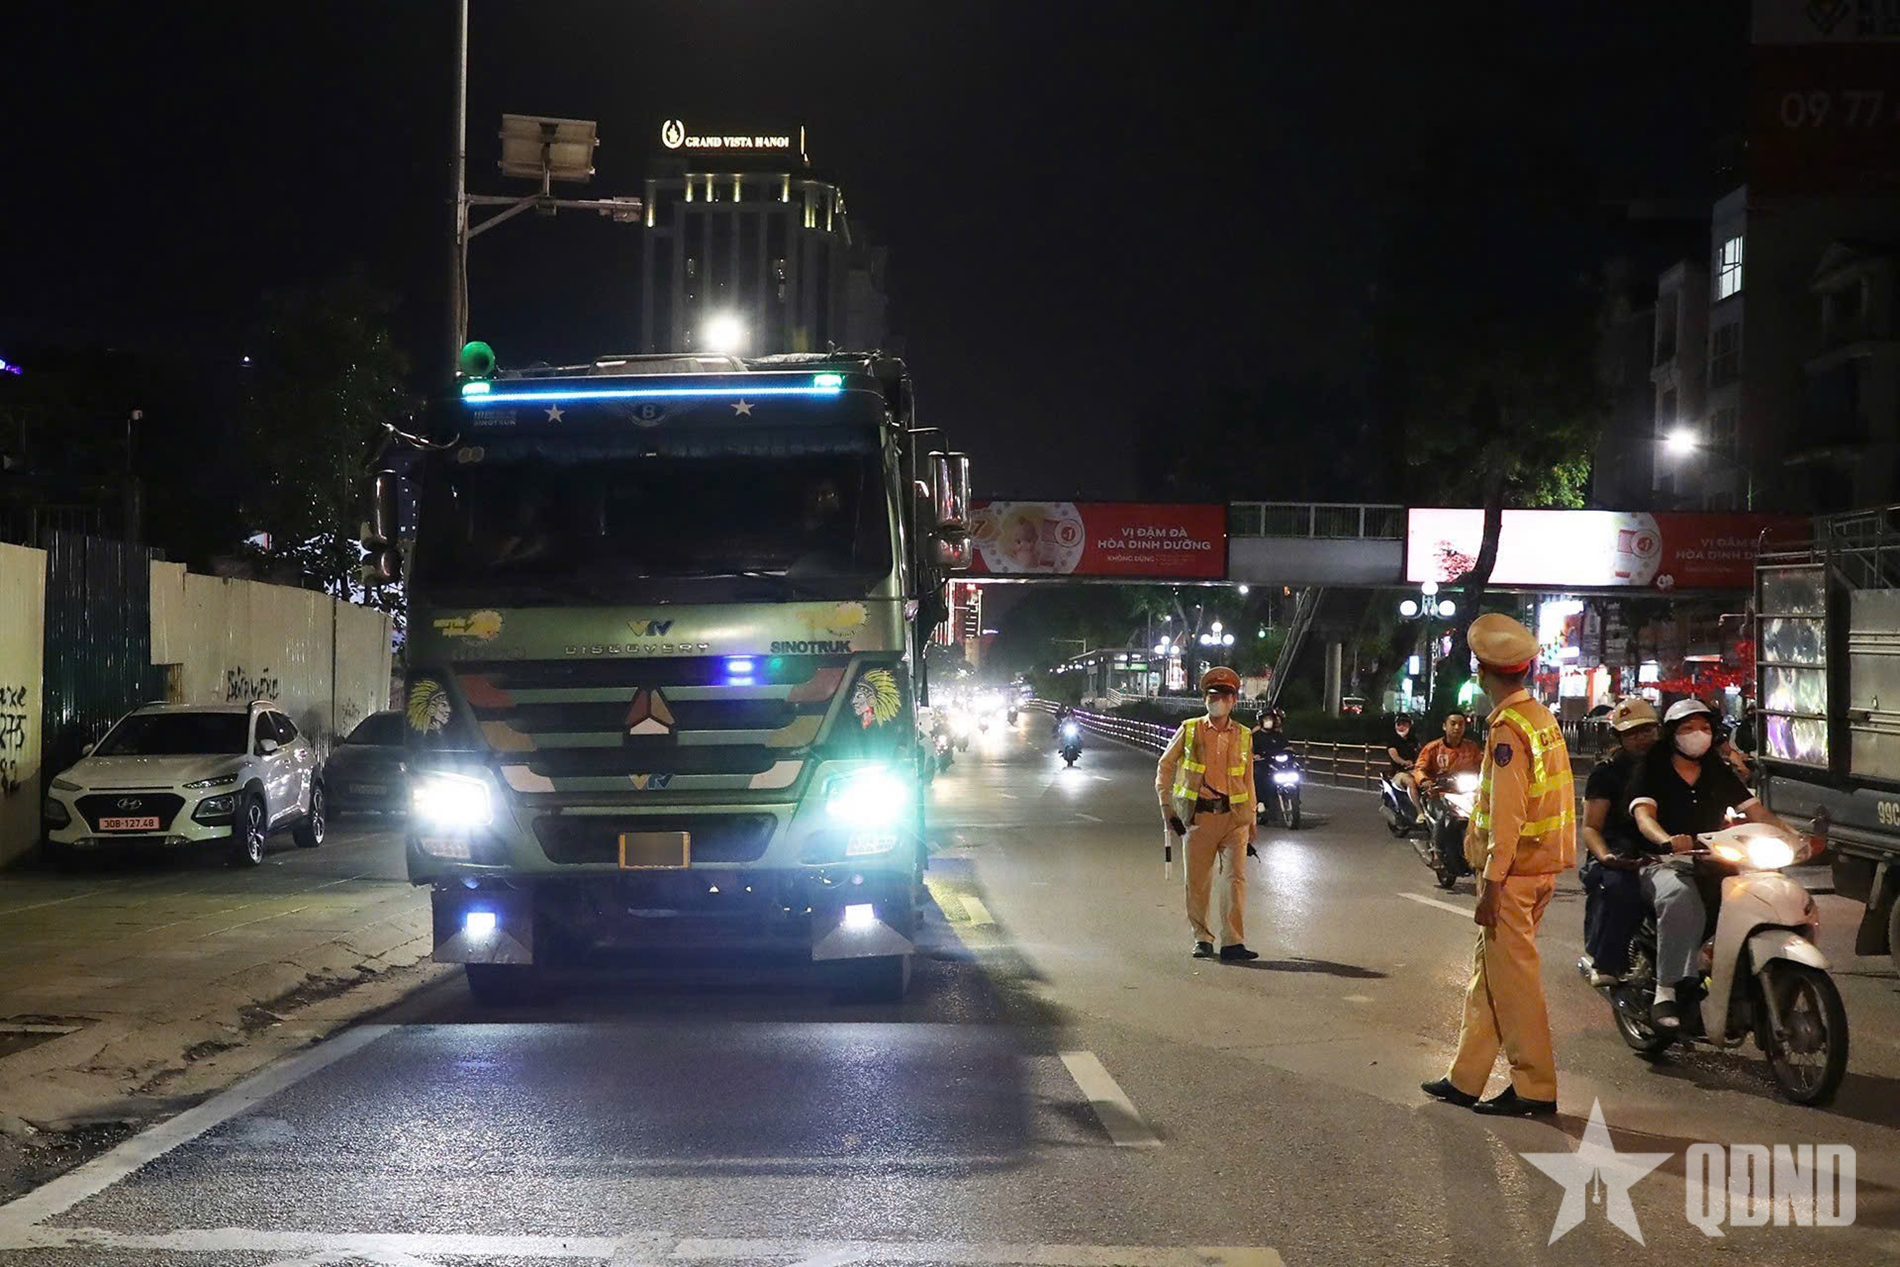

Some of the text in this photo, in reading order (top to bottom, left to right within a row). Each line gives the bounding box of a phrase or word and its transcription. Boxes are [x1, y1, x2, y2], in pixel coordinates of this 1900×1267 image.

[685, 136, 790, 148] GRAND VISTA HANOI
[1121, 526, 1188, 539] VỊ ĐẬM ĐÀ
[1098, 537, 1211, 550] HÒA DINH DƯỠNG
[565, 642, 710, 655] DISCOVERY
[770, 640, 852, 654] SINOTRUK
[104, 818, 155, 829] 30B-127.48
